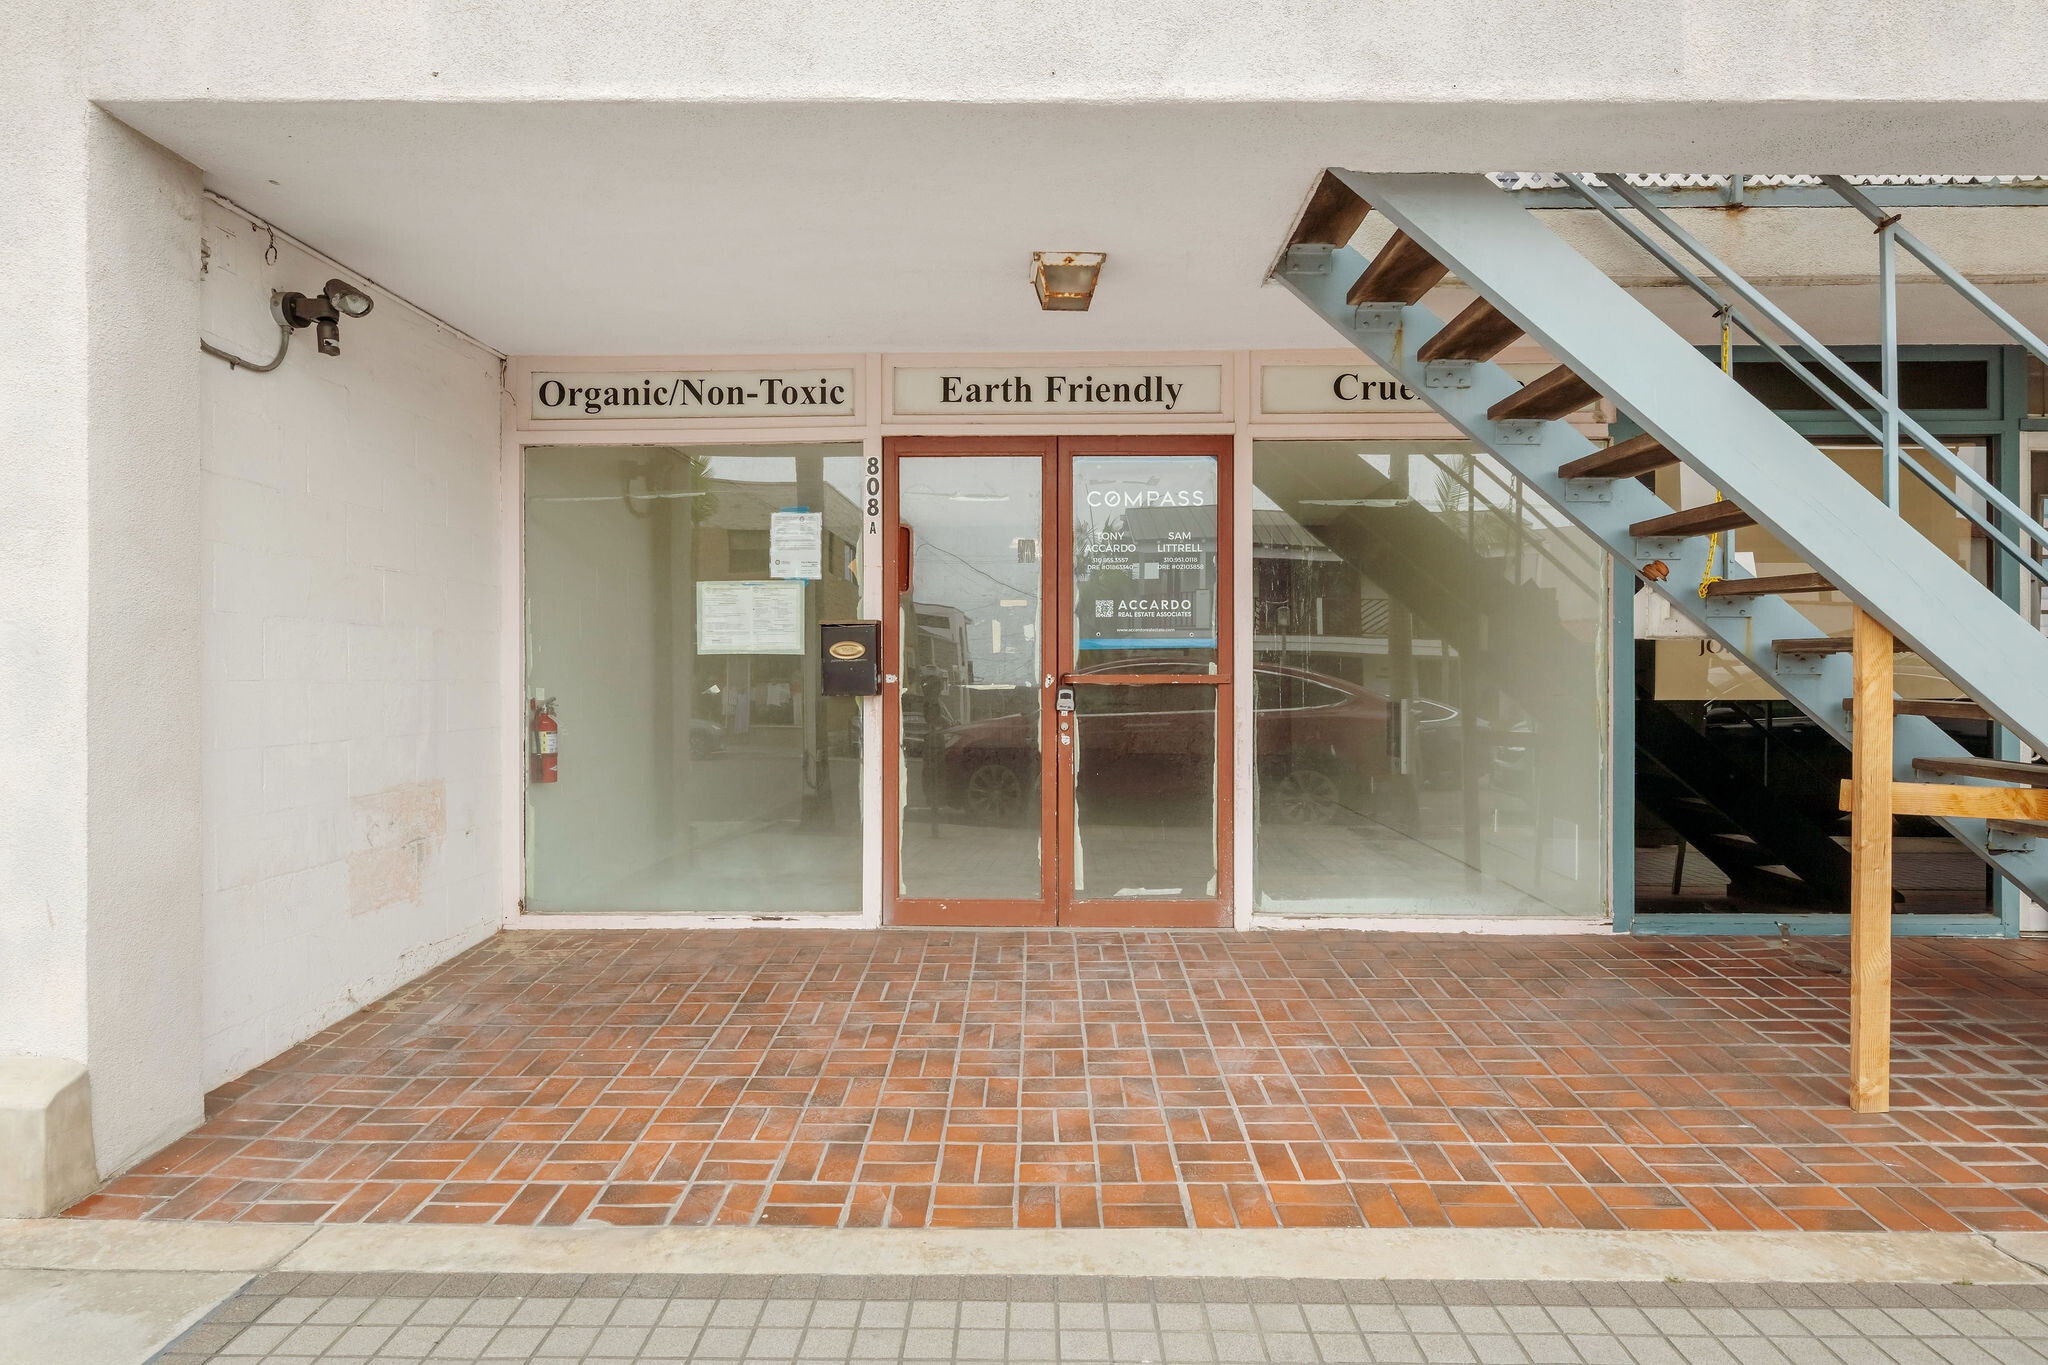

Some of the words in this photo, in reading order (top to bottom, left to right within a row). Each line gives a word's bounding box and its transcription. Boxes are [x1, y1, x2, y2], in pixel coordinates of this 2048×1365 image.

[940, 375, 1033, 404] Earth
[1044, 375, 1184, 411] Friendly
[1334, 373, 1421, 400] Crue
[538, 377, 845, 415] Organic/Non-Toxic
[866, 456, 880, 517] 808
[1087, 490, 1204, 507] COMPASS
[869, 521, 877, 535] A
[1168, 531, 1191, 540] SAM
[1098, 531, 1124, 541] TONY
[1084, 544, 1136, 553] ACCARDO
[1157, 543, 1203, 552] LITTRELL
[1118, 599, 1192, 610] ACCARDO
[1698, 639, 1730, 656] JO
